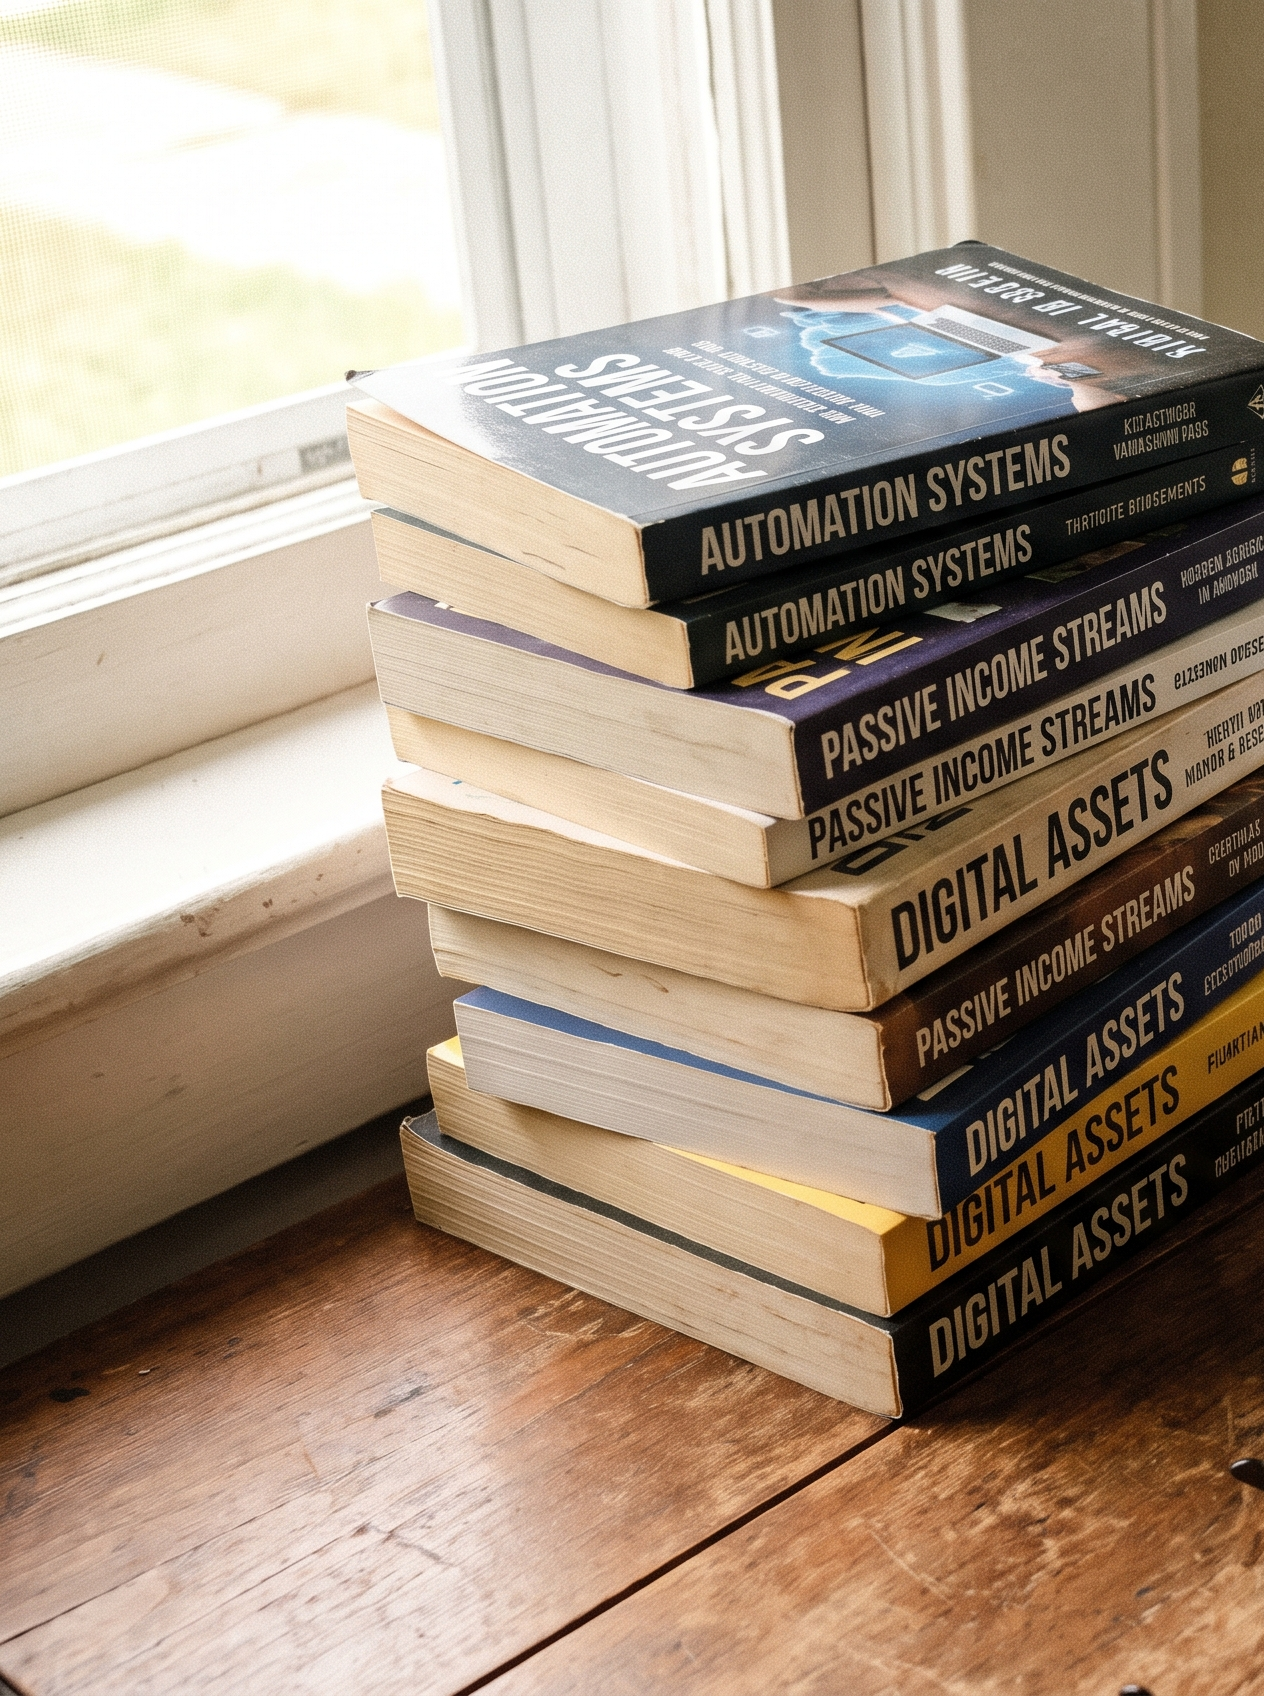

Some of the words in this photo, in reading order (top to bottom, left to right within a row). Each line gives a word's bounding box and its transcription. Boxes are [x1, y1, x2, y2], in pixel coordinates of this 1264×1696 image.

[443, 358, 768, 491] AUTOMATION
[554, 353, 825, 456] SYSTEMS
[700, 473, 920, 576] AUTOMATION
[926, 433, 1071, 512] SYSTEMS
[724, 566, 905, 666] AUTOMATION
[912, 523, 1033, 600] SYSTEMS
[807, 771, 925, 861] PASSIVE
[932, 720, 1034, 804] INCOME
[1041, 673, 1156, 757] STREAMS
[820, 685, 941, 780] PASSIVE
[946, 630, 1048, 727] INCOME
[1054, 581, 1167, 670] STREAMS
[890, 835, 1038, 972] DIGITAL
[1046, 749, 1172, 879] ASSETS
[915, 976, 1009, 1068] PASSIVE
[1015, 928, 1097, 1011] INCOME
[1102, 865, 1196, 953] STREAMS
[926, 1149, 1056, 1272] DIGITAL
[1065, 1064, 1180, 1183] ASSETS
[965, 1067, 1078, 1177] DIGITAL
[1085, 970, 1186, 1081] ASSETS
[928, 1245, 1062, 1378] DIGITAL
[1070, 1153, 1190, 1281] ASSETS
